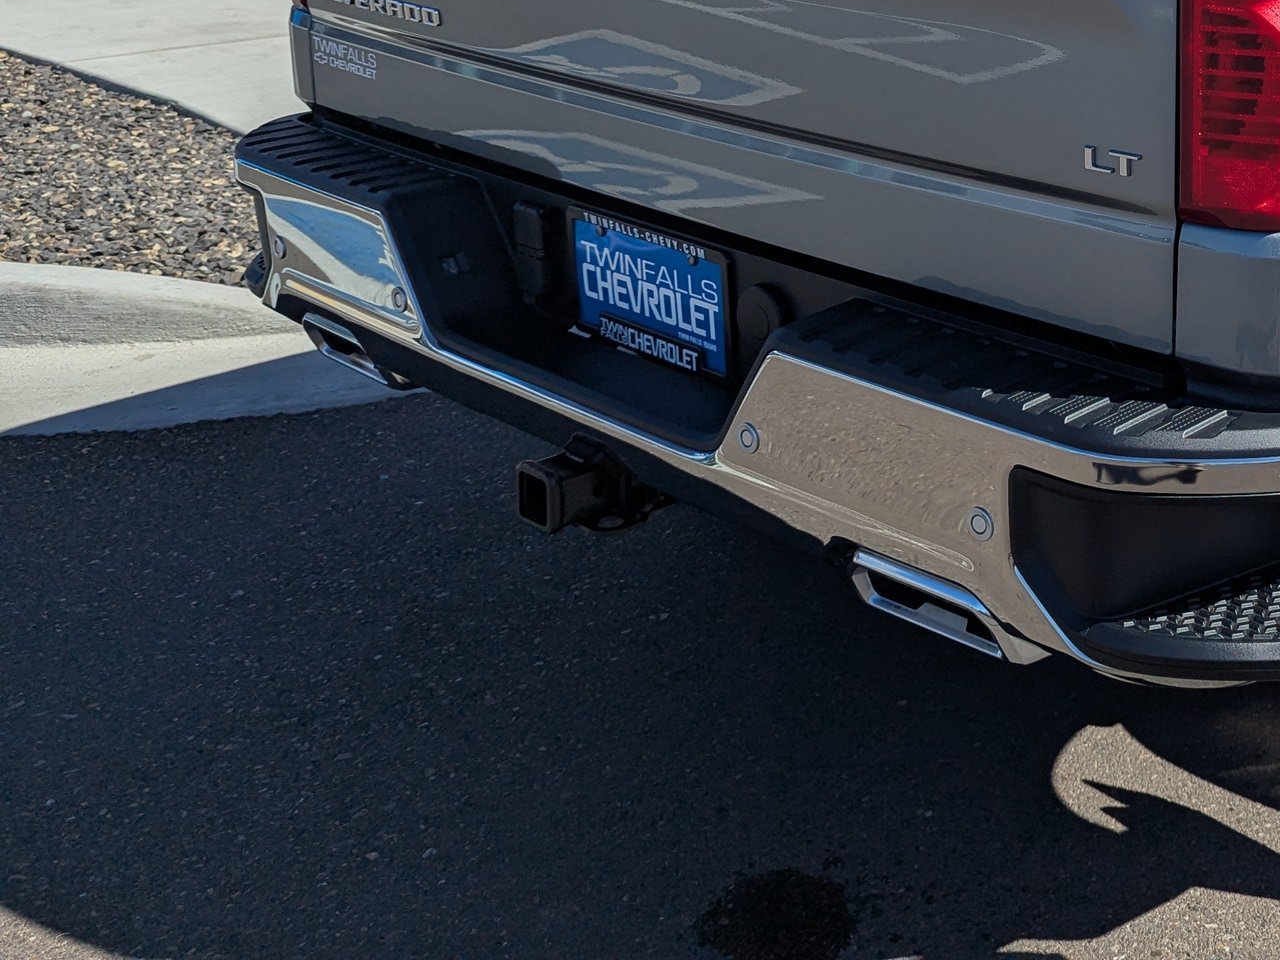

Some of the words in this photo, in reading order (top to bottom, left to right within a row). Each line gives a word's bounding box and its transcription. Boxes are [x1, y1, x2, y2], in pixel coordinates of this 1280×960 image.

[329, 56, 377, 80] CHEVROLET
[1084, 144, 1143, 177] LT
[583, 211, 705, 260] TWINFALLS-CHEVY.COM
[582, 262, 719, 341] CHEVROLET
[600, 317, 629, 336] TWIN
[600, 329, 629, 346] FALLS
[627, 328, 698, 372] CHEVROLET
